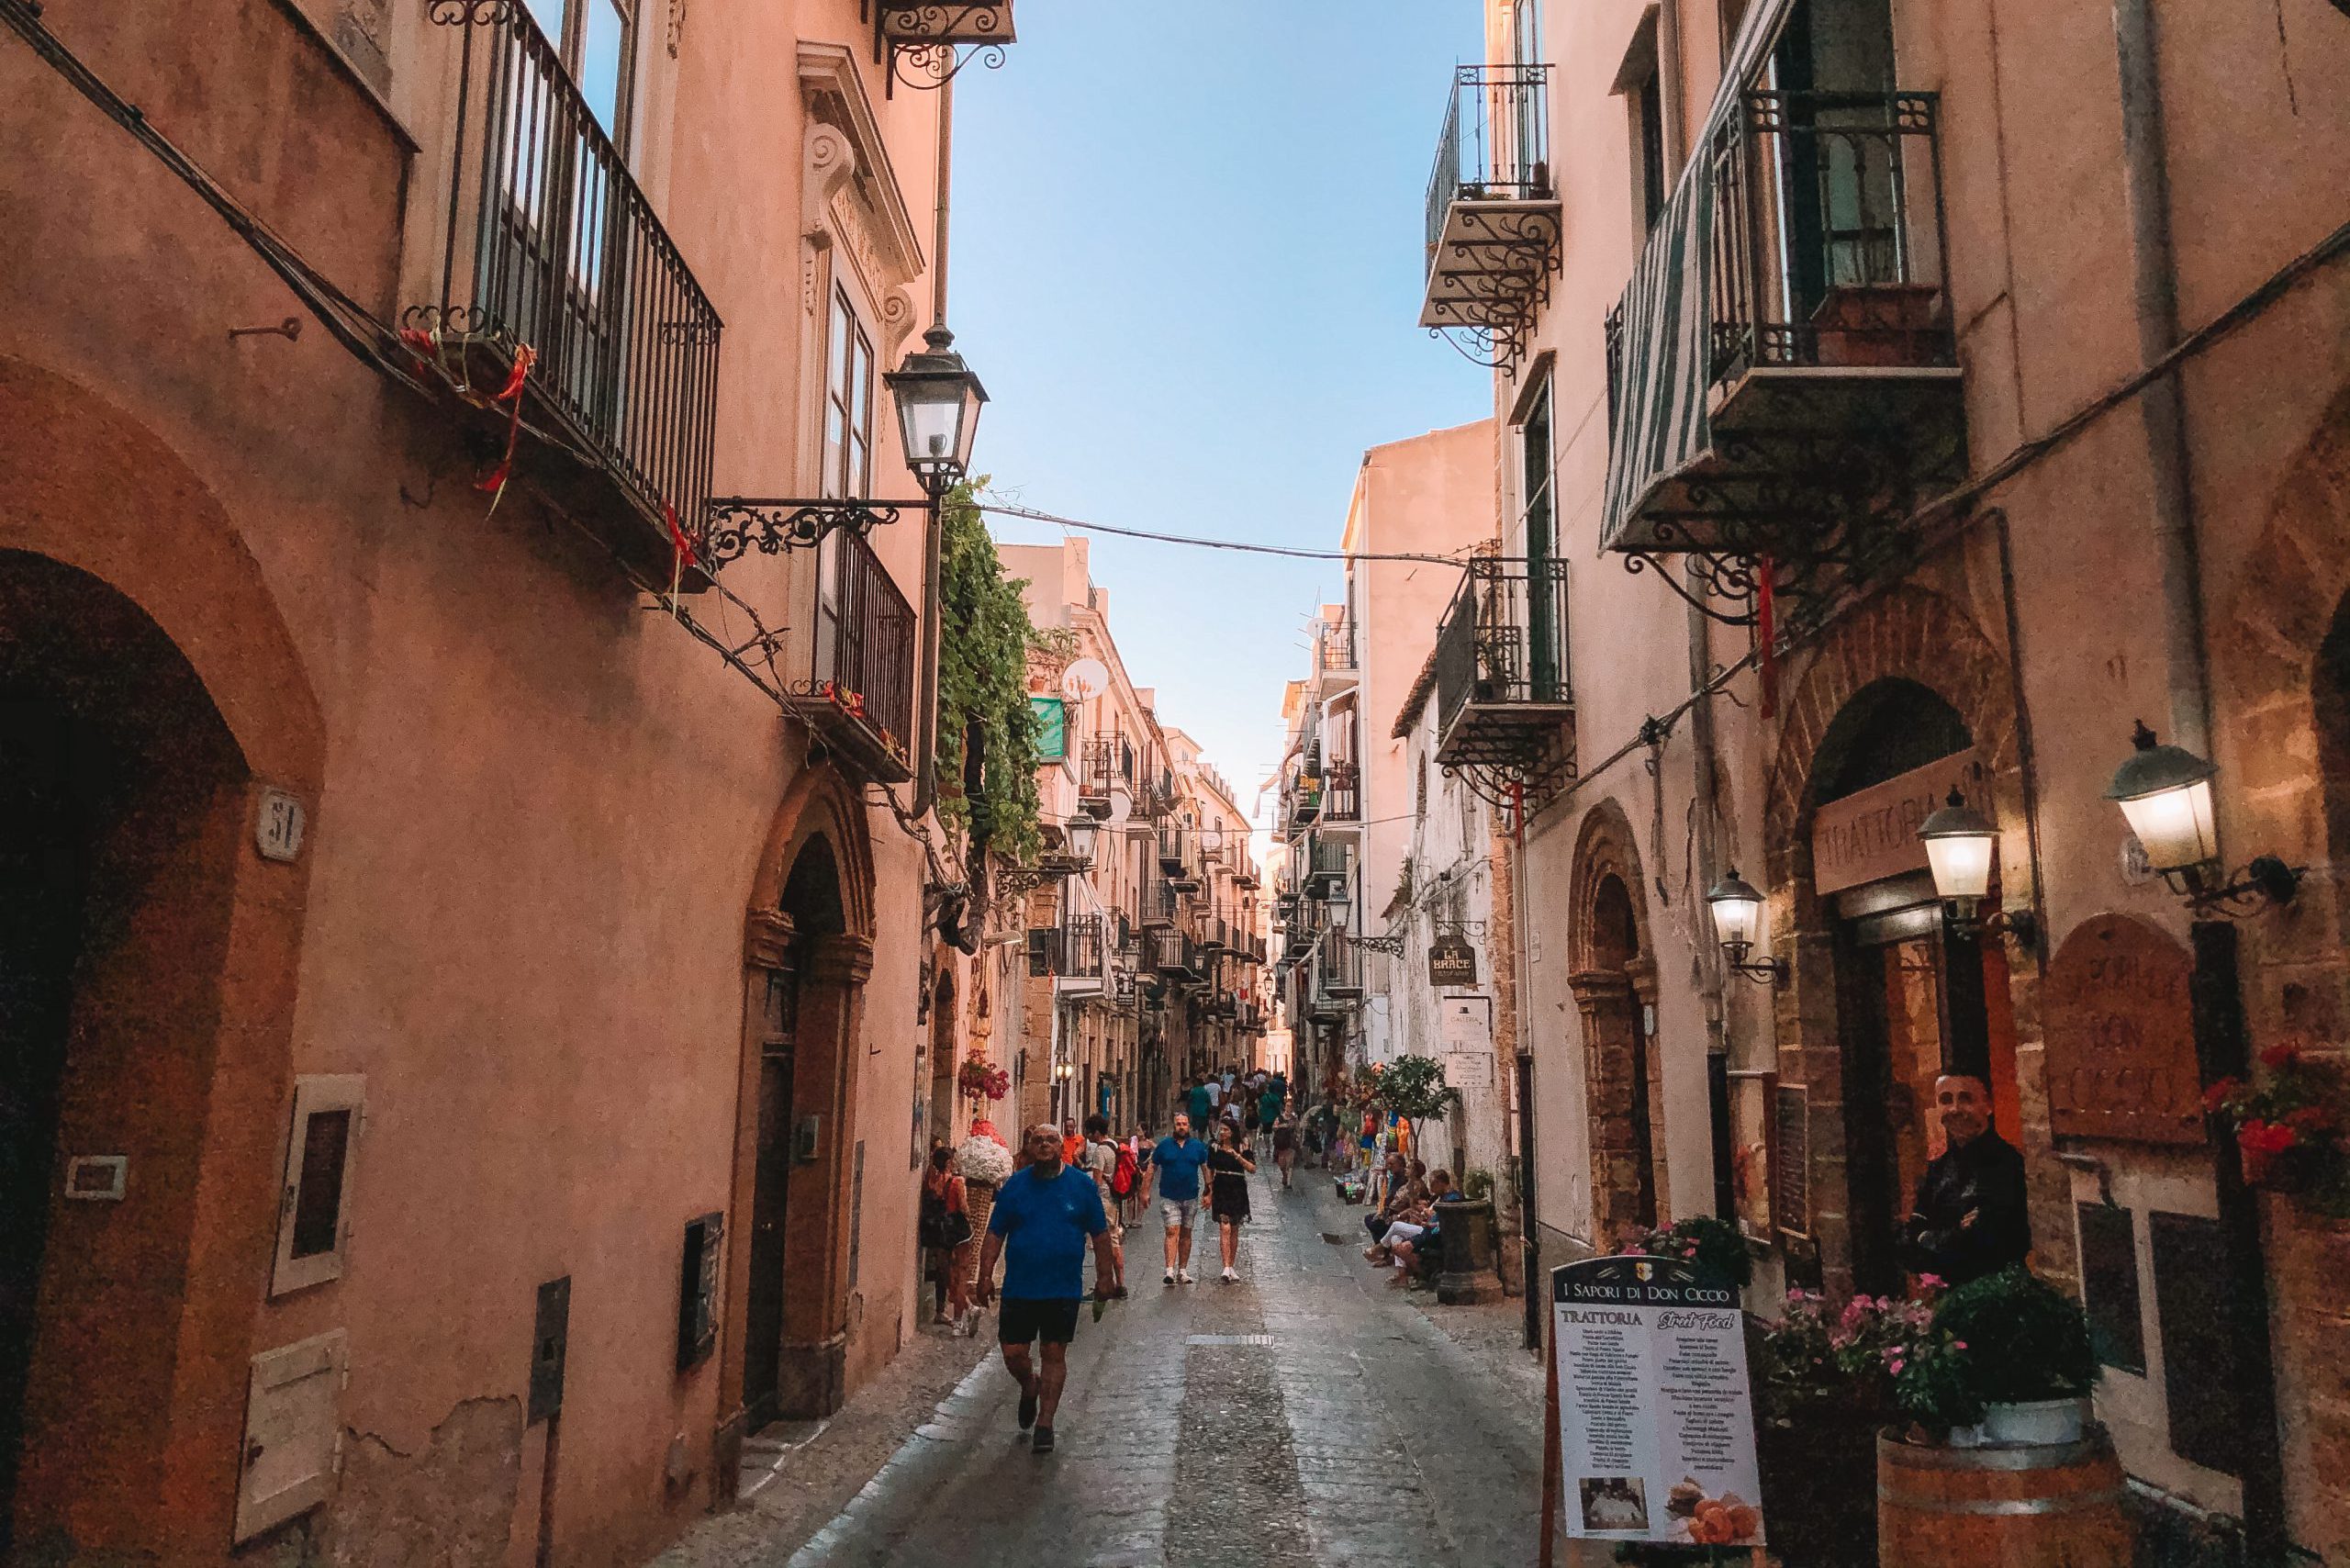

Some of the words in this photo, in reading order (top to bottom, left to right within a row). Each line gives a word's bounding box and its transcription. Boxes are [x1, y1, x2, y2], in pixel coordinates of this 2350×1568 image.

[1443, 950, 1459, 960] LA
[1433, 959, 1471, 969] BRACE
[1563, 1283, 1568, 1296] I
[1573, 1284, 1620, 1299] SAPORI
[1627, 1287, 1640, 1299] DI
[1648, 1287, 1678, 1301] DON
[1684, 1288, 1729, 1302] CICCIO
[1561, 1310, 1643, 1327] TRATTORIA
[1656, 1311, 1699, 1329] Street
[1698, 1312, 1735, 1330] Food
